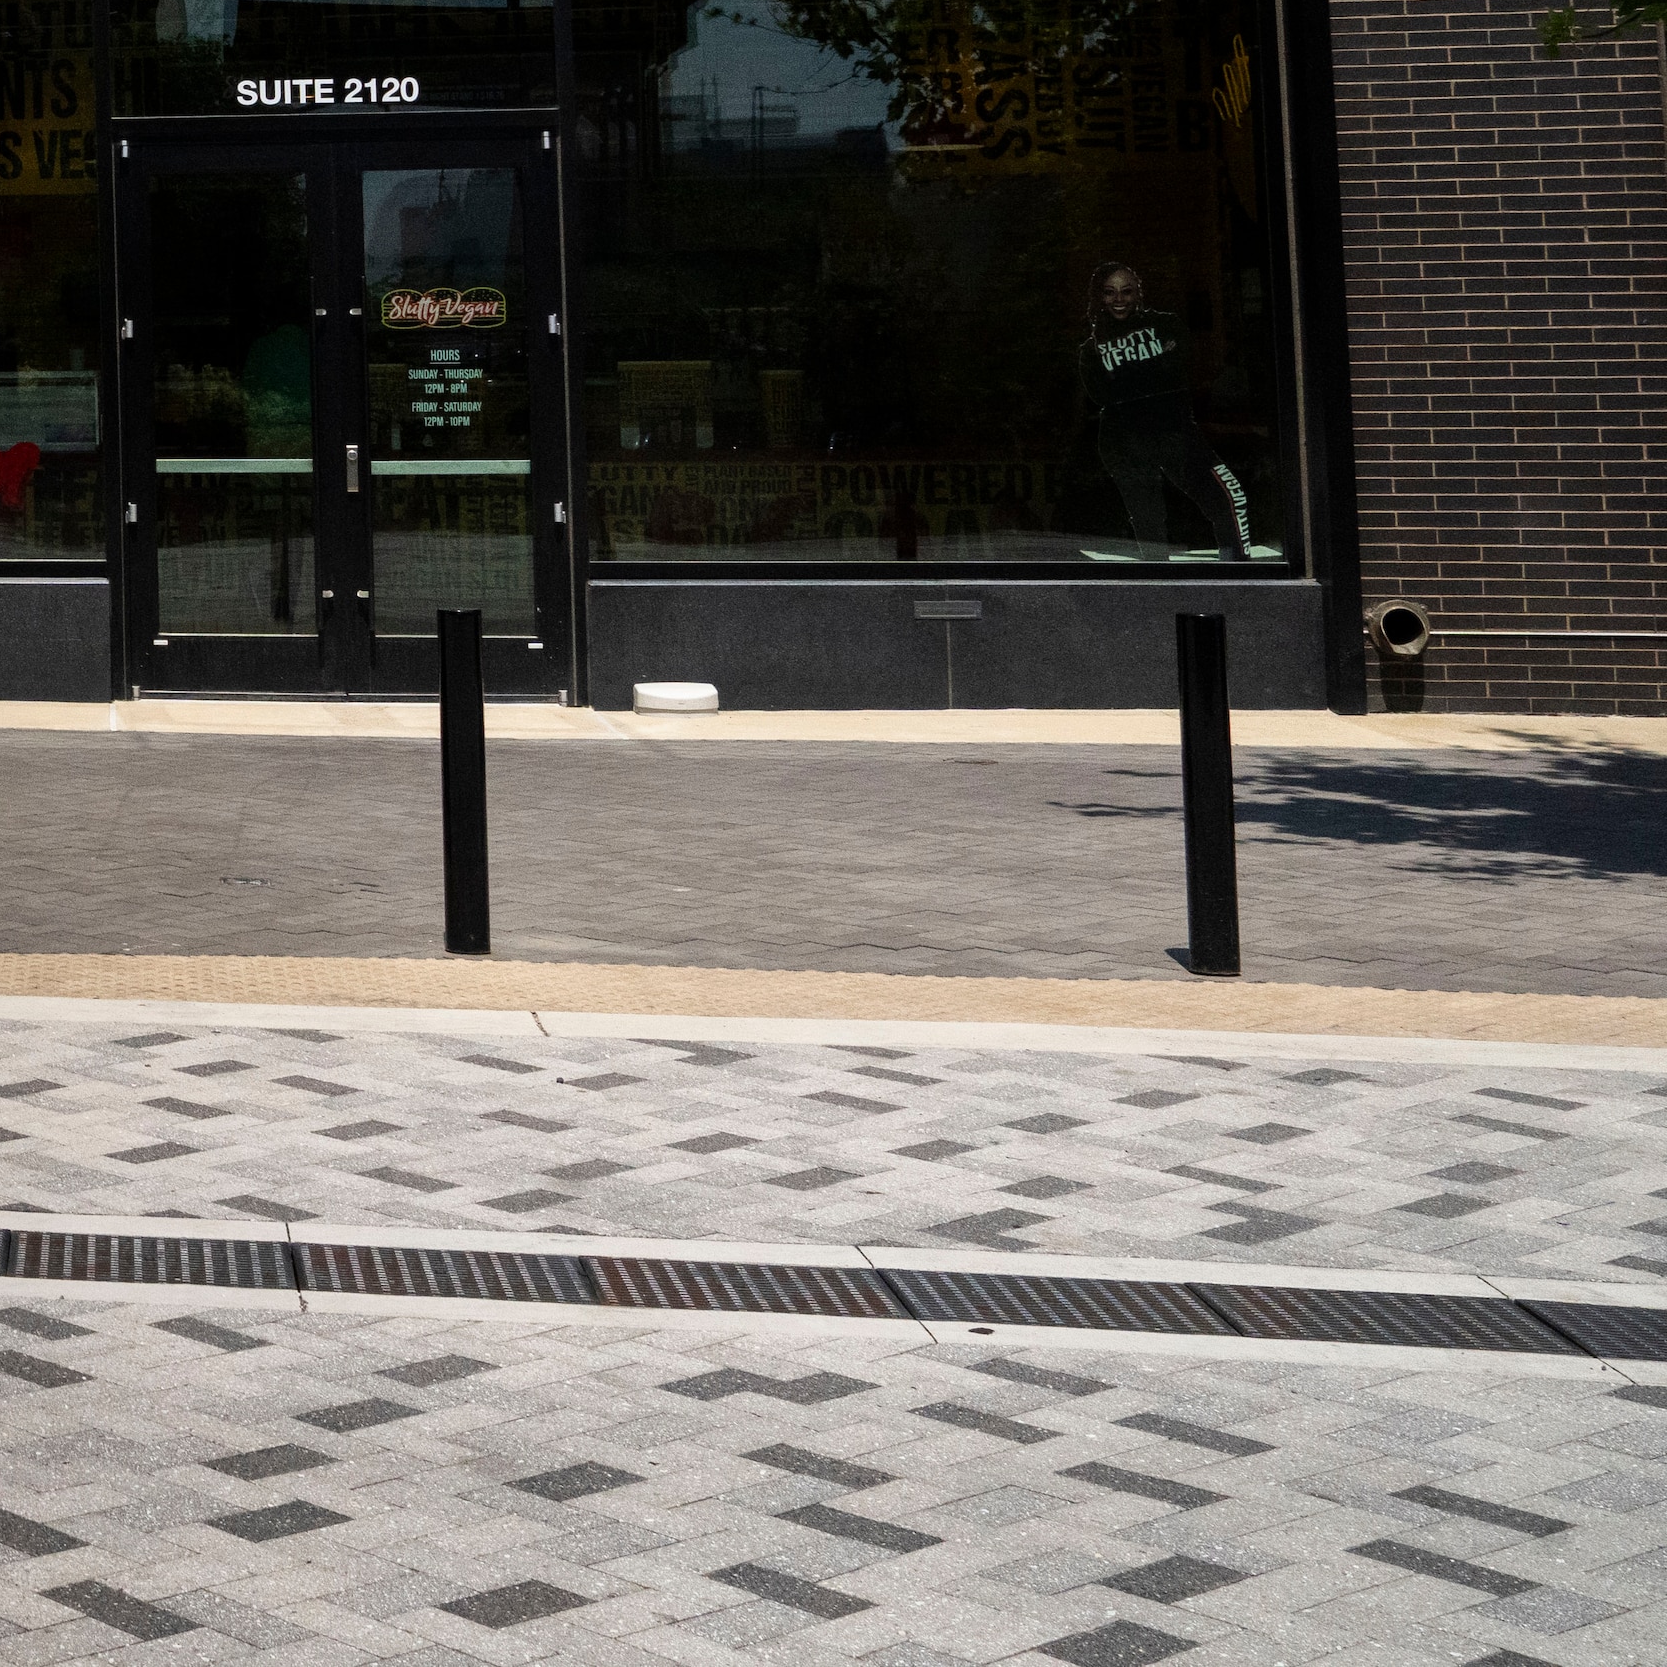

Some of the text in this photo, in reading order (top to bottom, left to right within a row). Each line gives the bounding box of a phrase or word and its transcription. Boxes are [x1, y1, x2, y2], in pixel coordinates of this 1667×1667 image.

[236, 76, 420, 107] SUITE 2120
[1132, 61, 1167, 153] VEGAN
[388, 291, 499, 325] Slutty Vegan
[430, 349, 461, 362] HOURS
[1097, 327, 1156, 355] SLUTTY
[1102, 339, 1164, 372] VEGAN
[408, 368, 438, 380] SUNDAY
[444, 368, 484, 380] THURSDAY
[424, 383, 444, 394] 12PM
[450, 383, 468, 394] 8PM
[411, 401, 438, 413] FRIDAY
[444, 401, 482, 413] SATURDAY
[424, 416, 444, 427] 12PM
[449, 416, 471, 427] 10PM
[587, 465, 678, 481] LUTTY
[820, 463, 1033, 506] POWERED
[1213, 463, 1248, 505] VEGAN
[1234, 504, 1251, 556] SLUTTY
